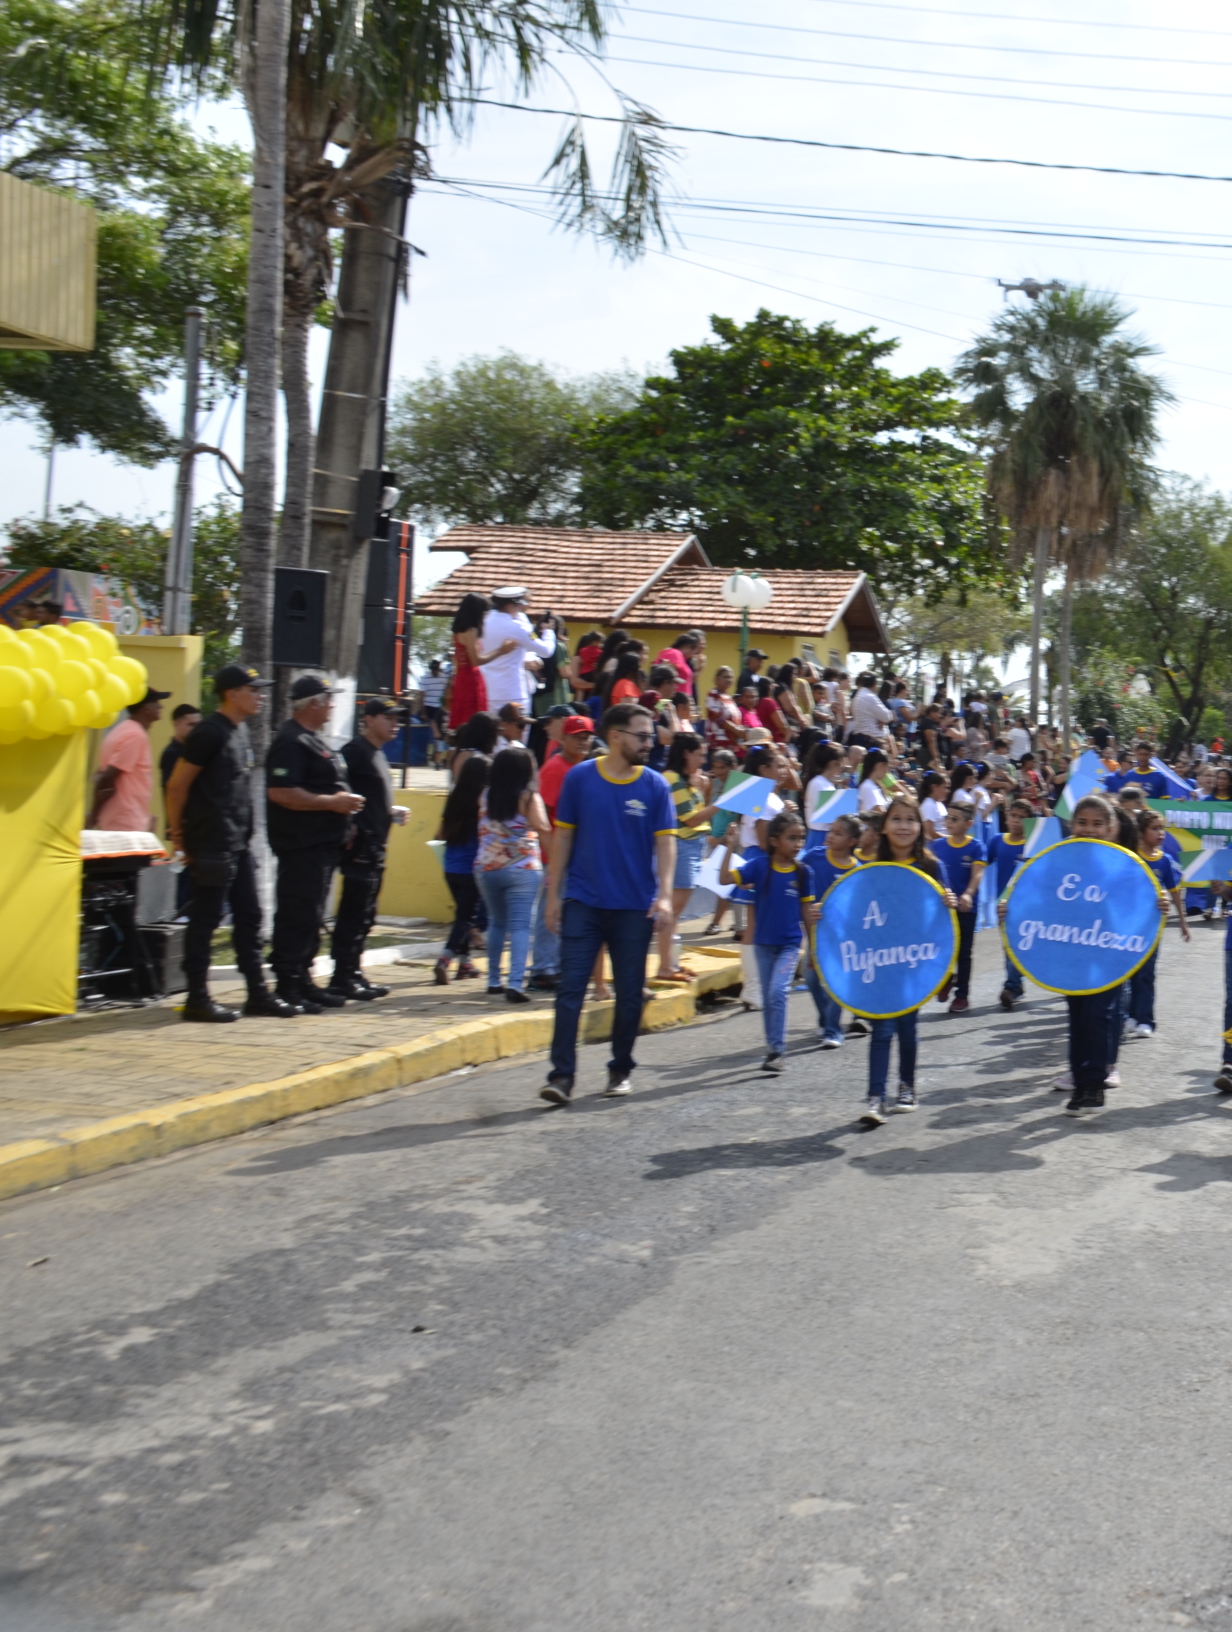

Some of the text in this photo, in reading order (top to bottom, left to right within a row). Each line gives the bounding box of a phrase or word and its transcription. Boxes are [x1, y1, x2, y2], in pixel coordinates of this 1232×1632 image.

[1056, 873, 1108, 902] E a
[862, 900, 888, 930] A
[1017, 919, 1149, 953] grandeza
[840, 940, 940, 984] Pujança
